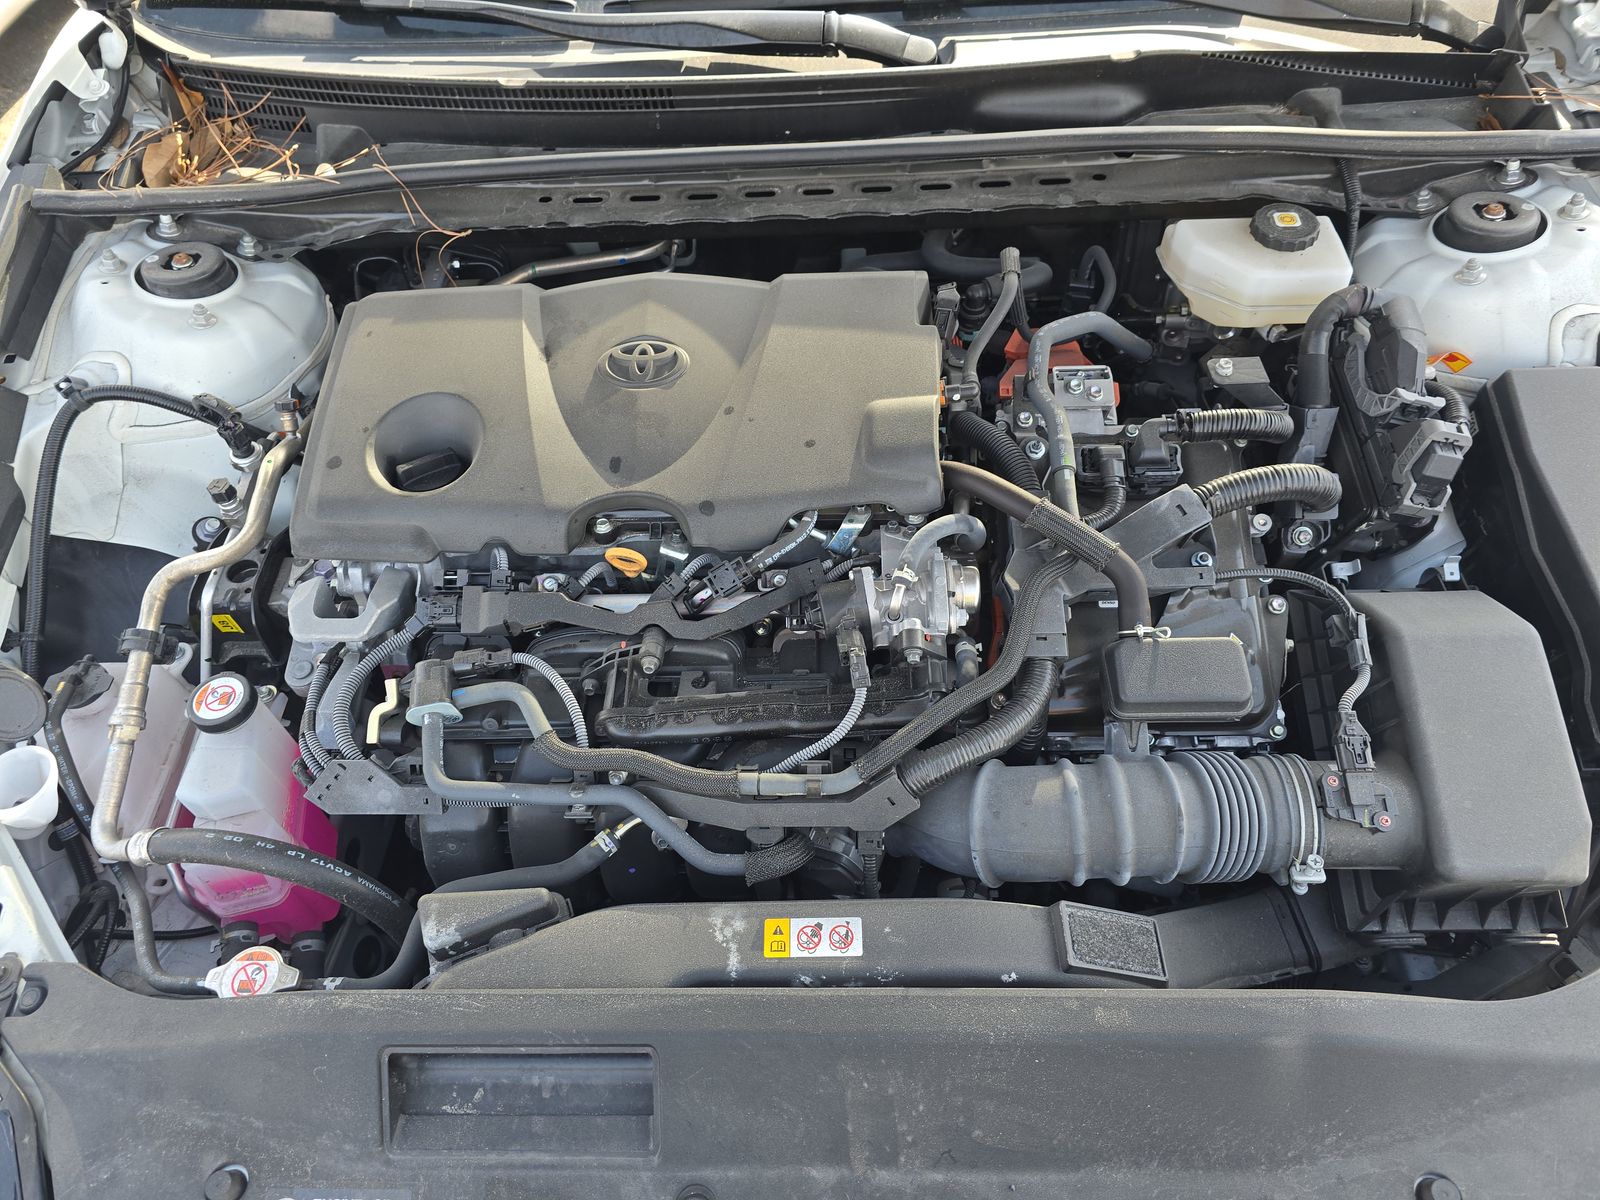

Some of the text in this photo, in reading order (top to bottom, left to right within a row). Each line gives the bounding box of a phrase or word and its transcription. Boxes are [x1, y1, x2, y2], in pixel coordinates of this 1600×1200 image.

[287, 850, 306, 859] LP
[310, 858, 352, 877] ACV17
[357, 876, 393, 901] YOKOHAMA
